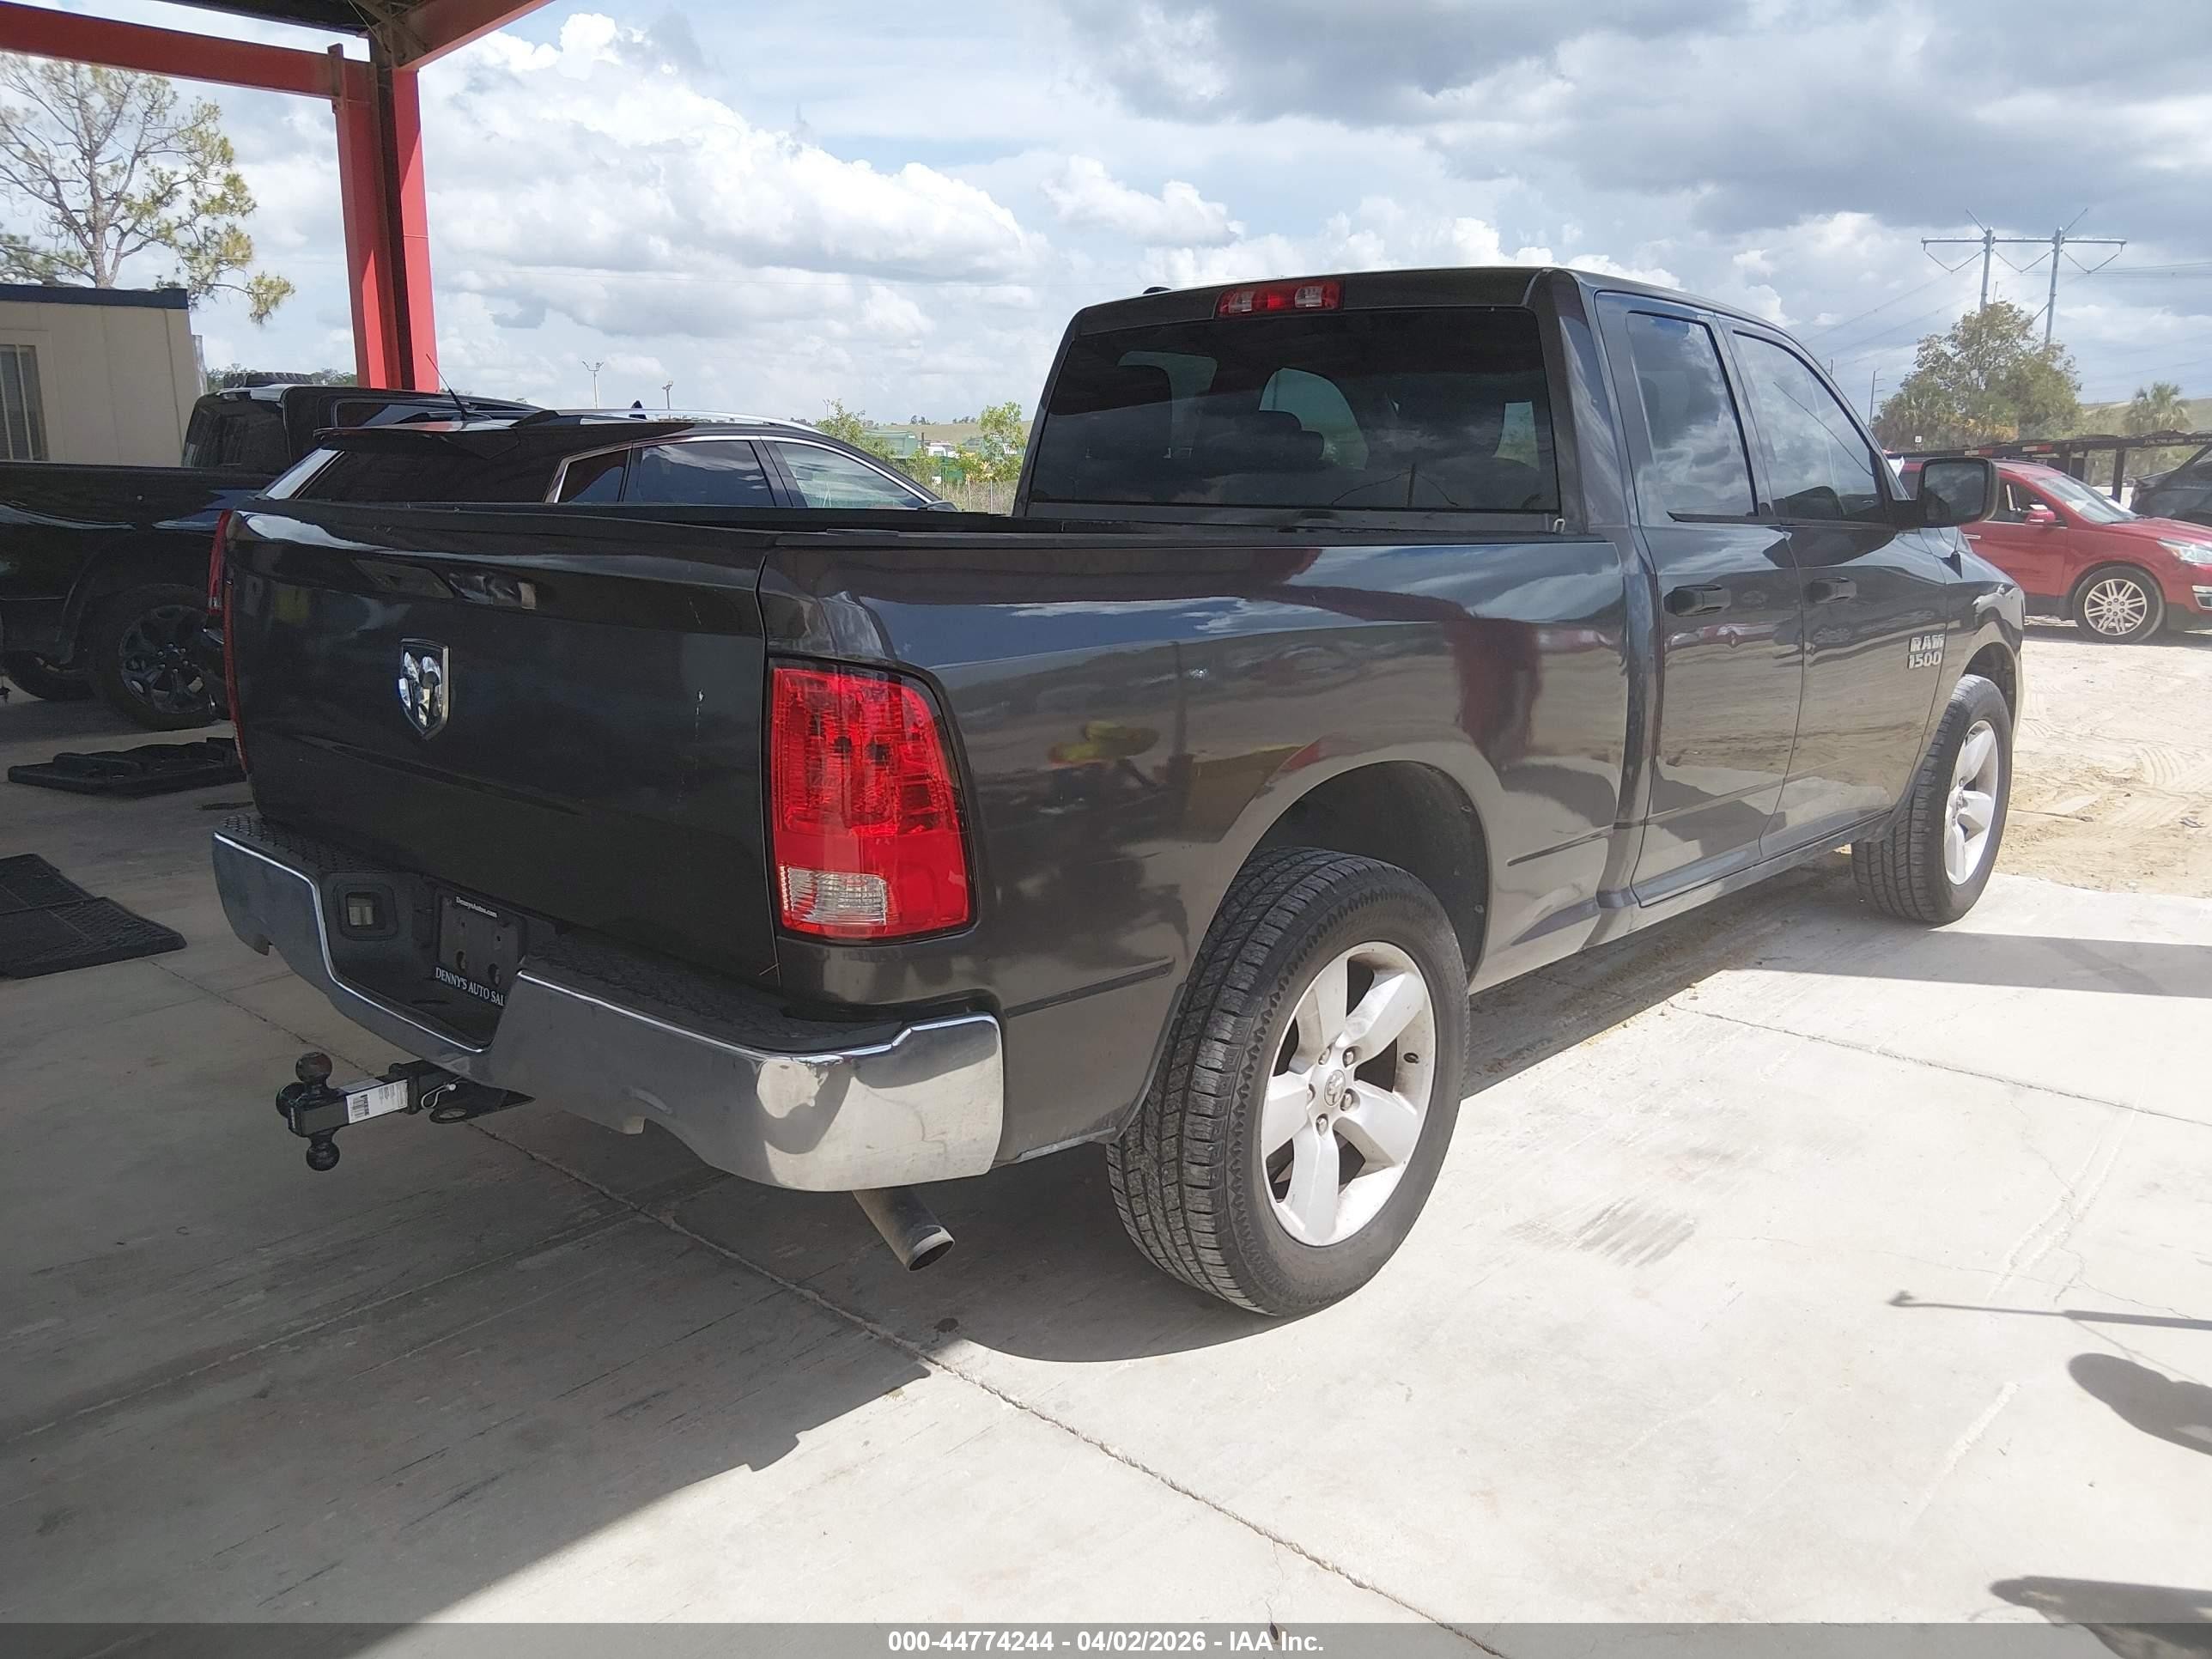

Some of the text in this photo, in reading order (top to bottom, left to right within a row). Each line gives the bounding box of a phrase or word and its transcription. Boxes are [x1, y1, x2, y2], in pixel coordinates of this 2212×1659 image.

[1910, 634, 1944, 652] RAM
[1908, 652, 1942, 669] 1500
[435, 967, 467, 990] DENNY'S
[468, 981, 490, 1000] AUTO
